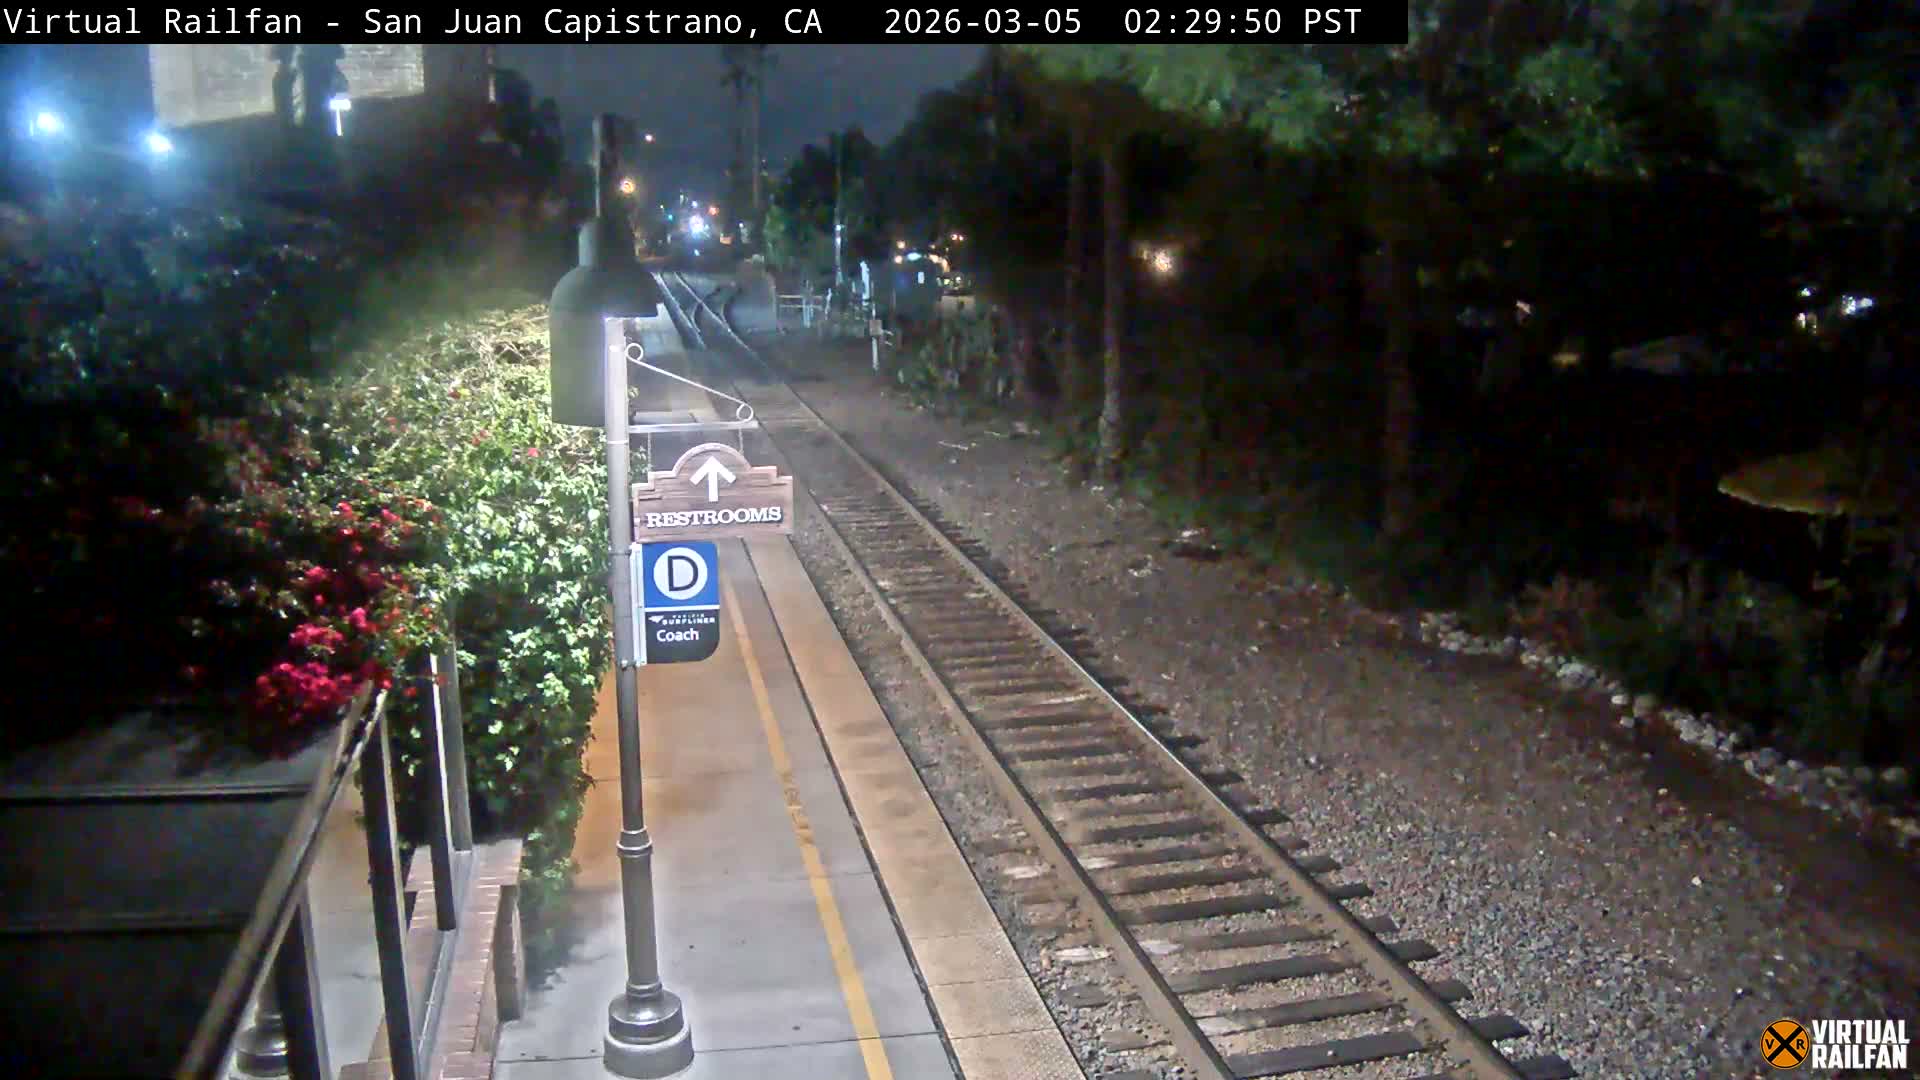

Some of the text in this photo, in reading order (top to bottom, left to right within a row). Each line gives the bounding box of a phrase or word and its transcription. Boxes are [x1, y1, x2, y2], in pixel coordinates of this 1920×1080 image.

[645, 506, 782, 529] RESTROOMS
[667, 554, 699, 592] D
[656, 627, 700, 642] Coach
